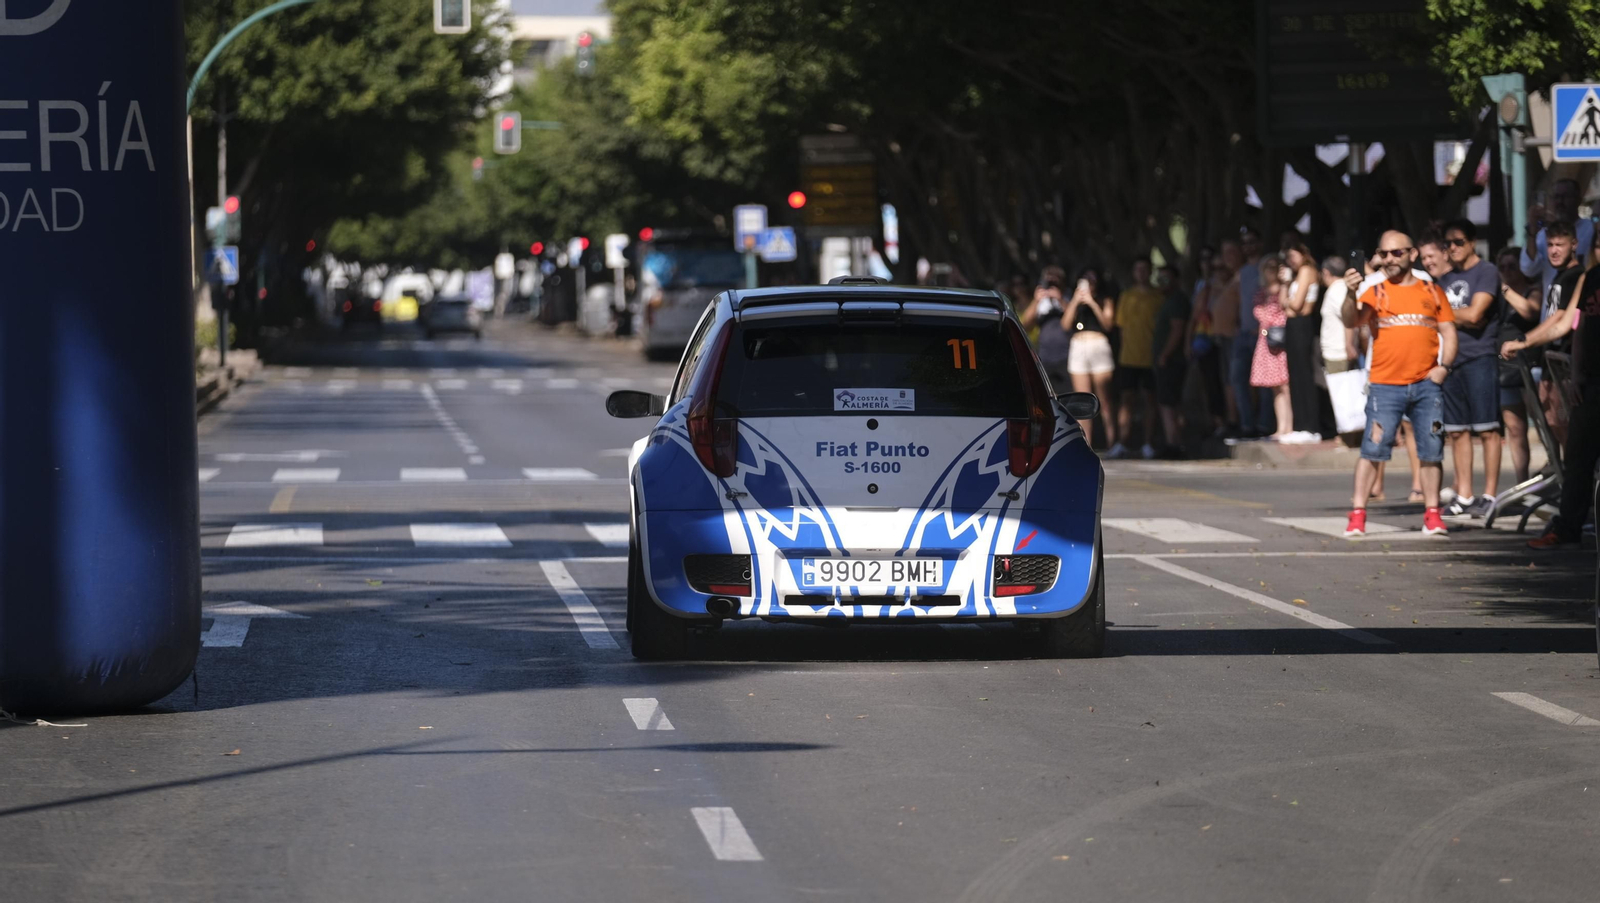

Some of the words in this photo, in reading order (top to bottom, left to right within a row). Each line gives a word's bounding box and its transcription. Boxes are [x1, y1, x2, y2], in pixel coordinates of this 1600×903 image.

[1312, 14, 1337, 31] DE
[0, 81, 156, 172] ERÍA
[946, 338, 977, 370] 11
[850, 400, 890, 409] ALMERÍA
[815, 441, 858, 457] Fiat
[865, 441, 930, 457] Punto
[843, 461, 901, 474] S-1600
[806, 573, 813, 581] E
[820, 560, 882, 583] 9902
[891, 560, 937, 583] BMH
